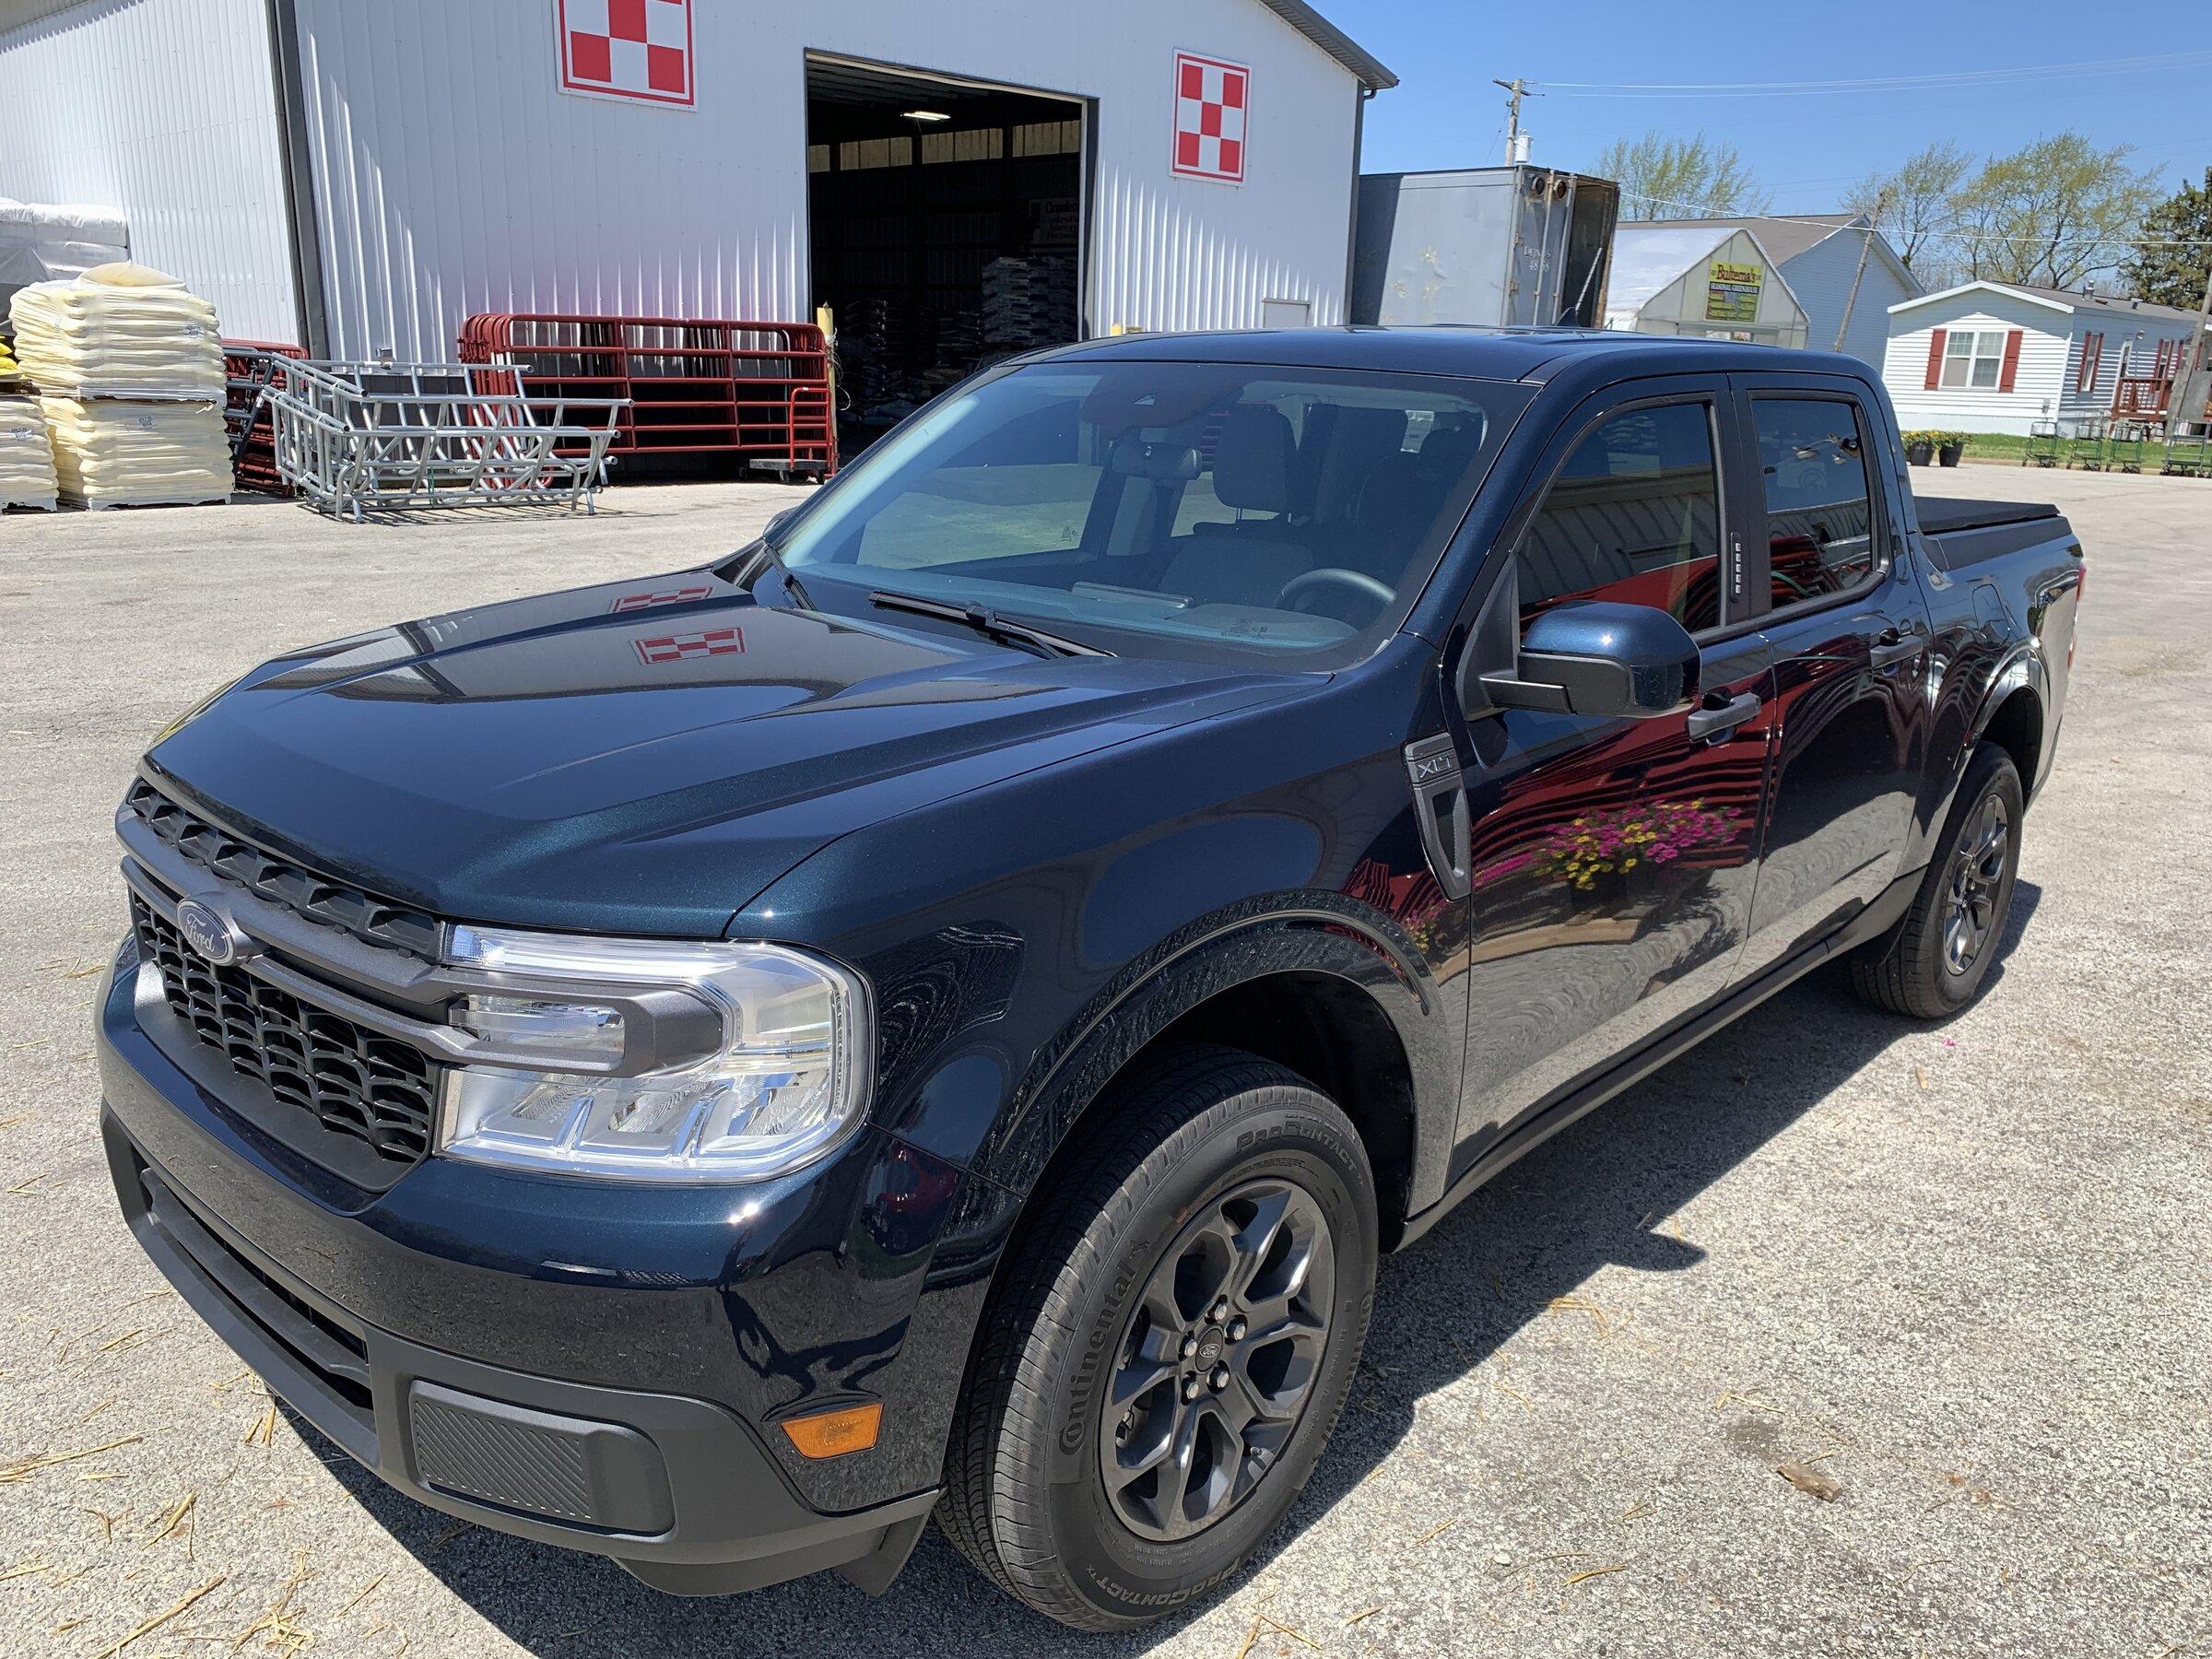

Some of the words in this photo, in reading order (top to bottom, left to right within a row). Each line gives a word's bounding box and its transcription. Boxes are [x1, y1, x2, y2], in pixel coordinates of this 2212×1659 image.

[1716, 264, 1757, 283] Bultema's
[1418, 756, 1456, 779] XLT
[185, 912, 216, 953] Ford
[1059, 1259, 1137, 1456] Continental
